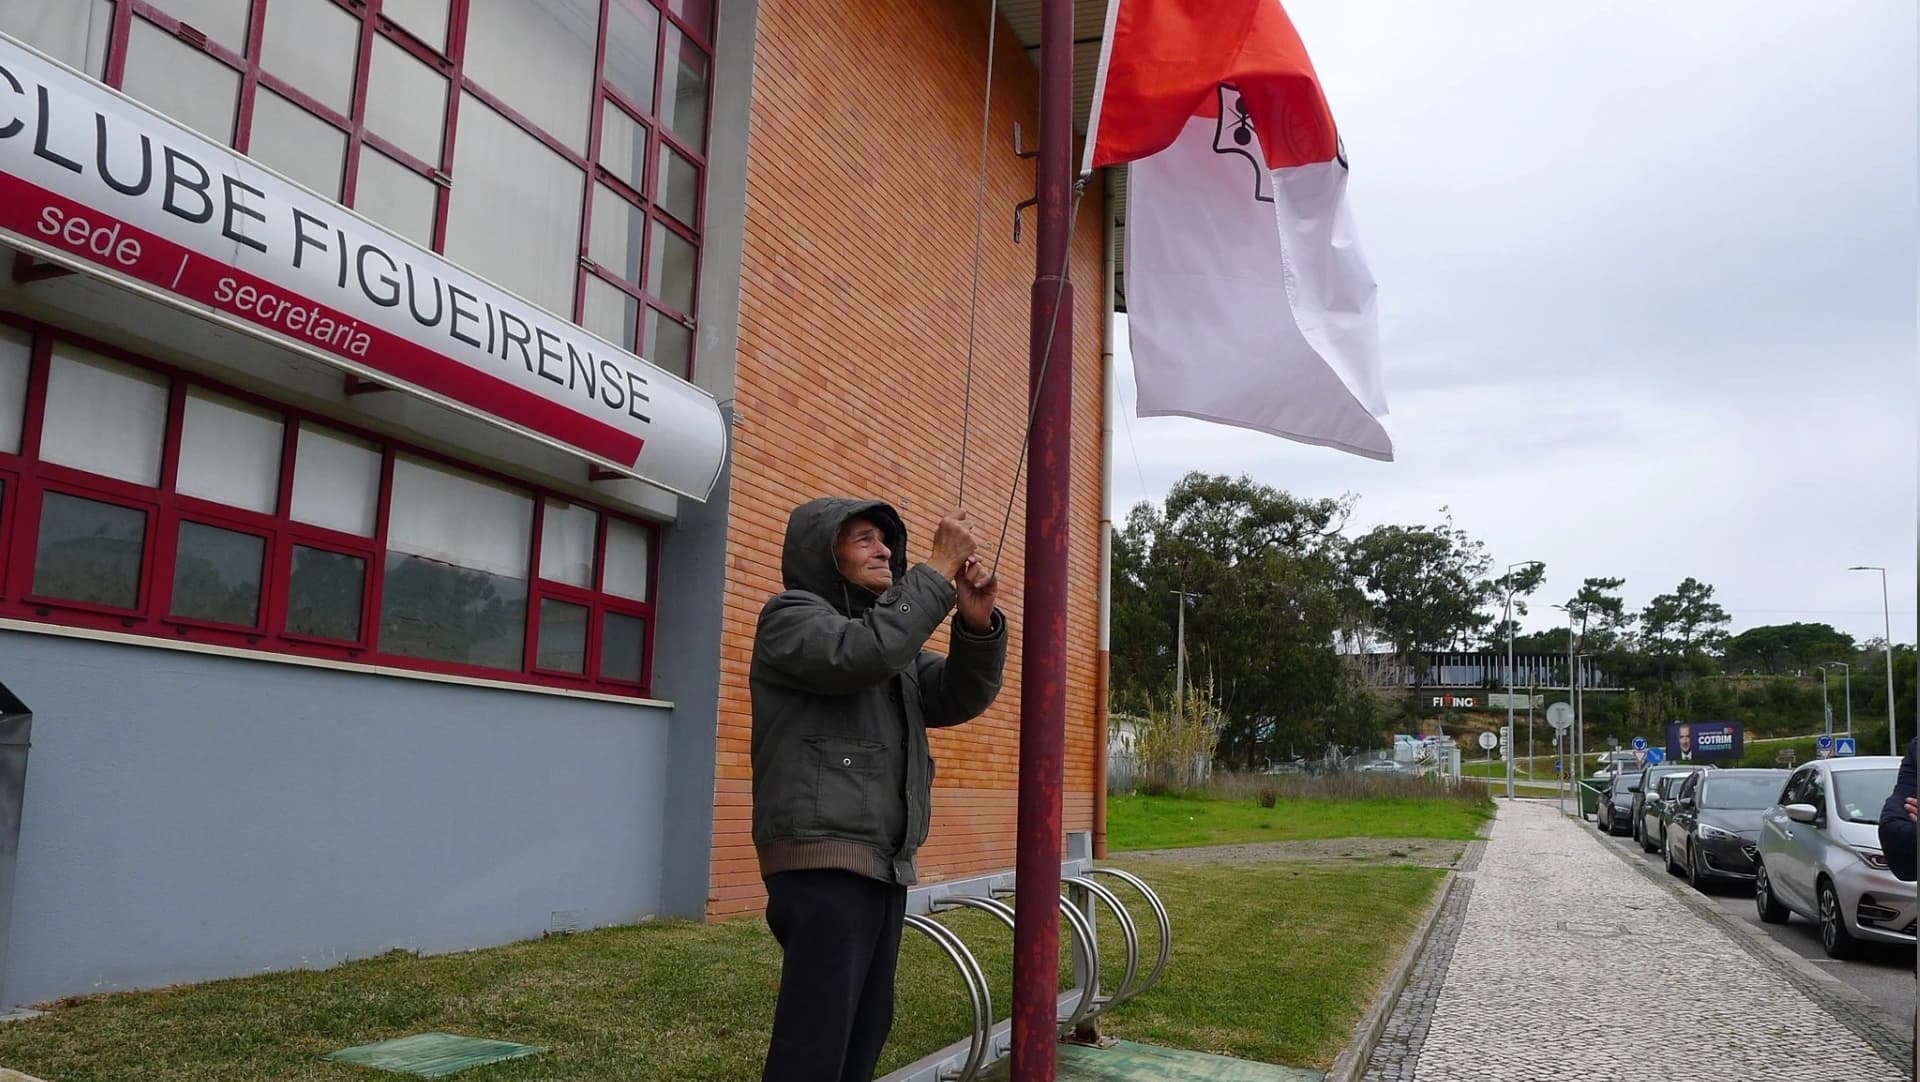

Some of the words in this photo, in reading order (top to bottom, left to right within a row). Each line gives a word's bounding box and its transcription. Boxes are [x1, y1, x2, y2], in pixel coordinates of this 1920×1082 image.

[36, 205, 142, 265] sede
[213, 276, 372, 357] secretaria
[292, 207, 651, 424] FIGUEIRENSE
[1698, 734, 1732, 745] COTRIM
